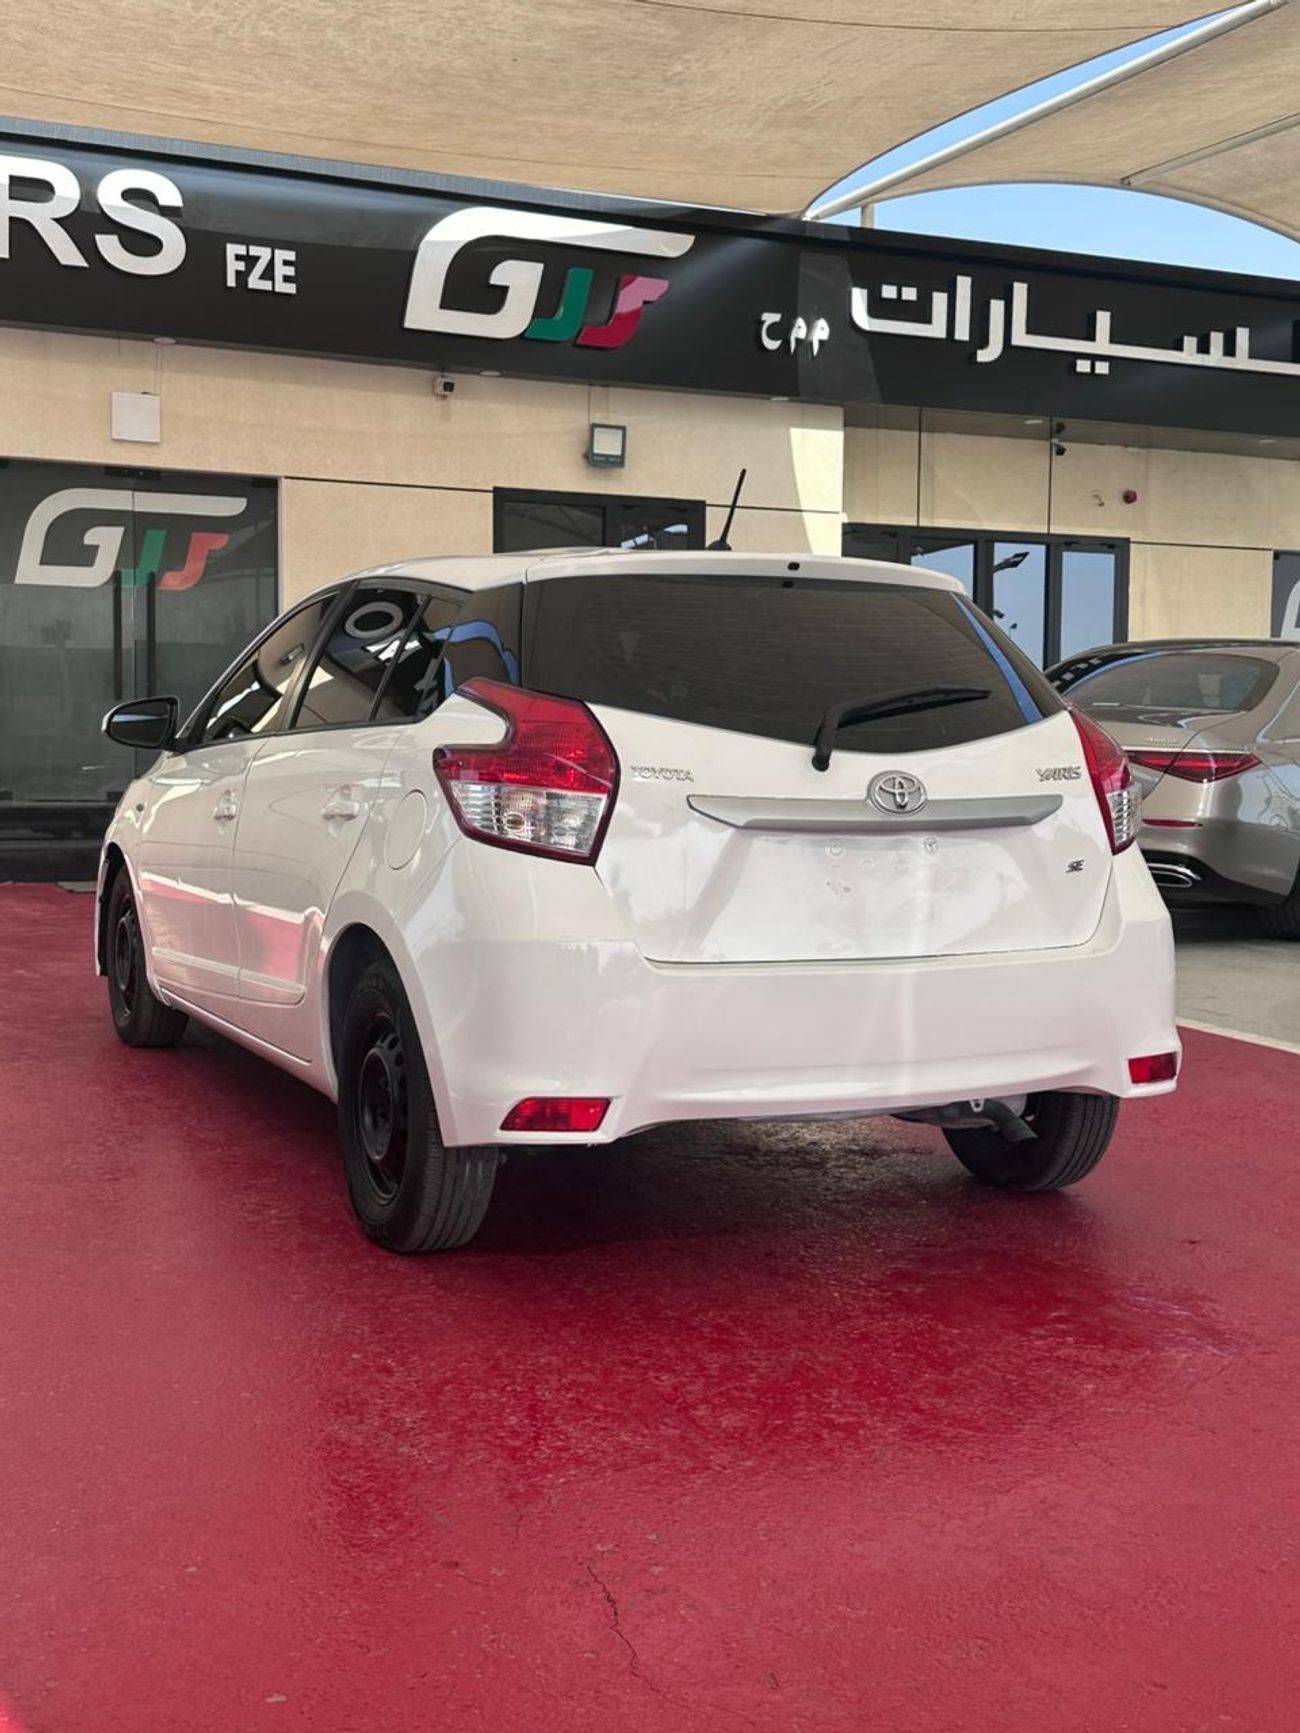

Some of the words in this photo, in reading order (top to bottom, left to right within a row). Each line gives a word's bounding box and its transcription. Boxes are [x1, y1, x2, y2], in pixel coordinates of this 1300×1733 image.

[226, 243, 297, 294] FZE
[851, 276, 1300, 376] سيارات
[629, 764, 695, 783] TOYOTA
[1035, 766, 1082, 782] YARIS
